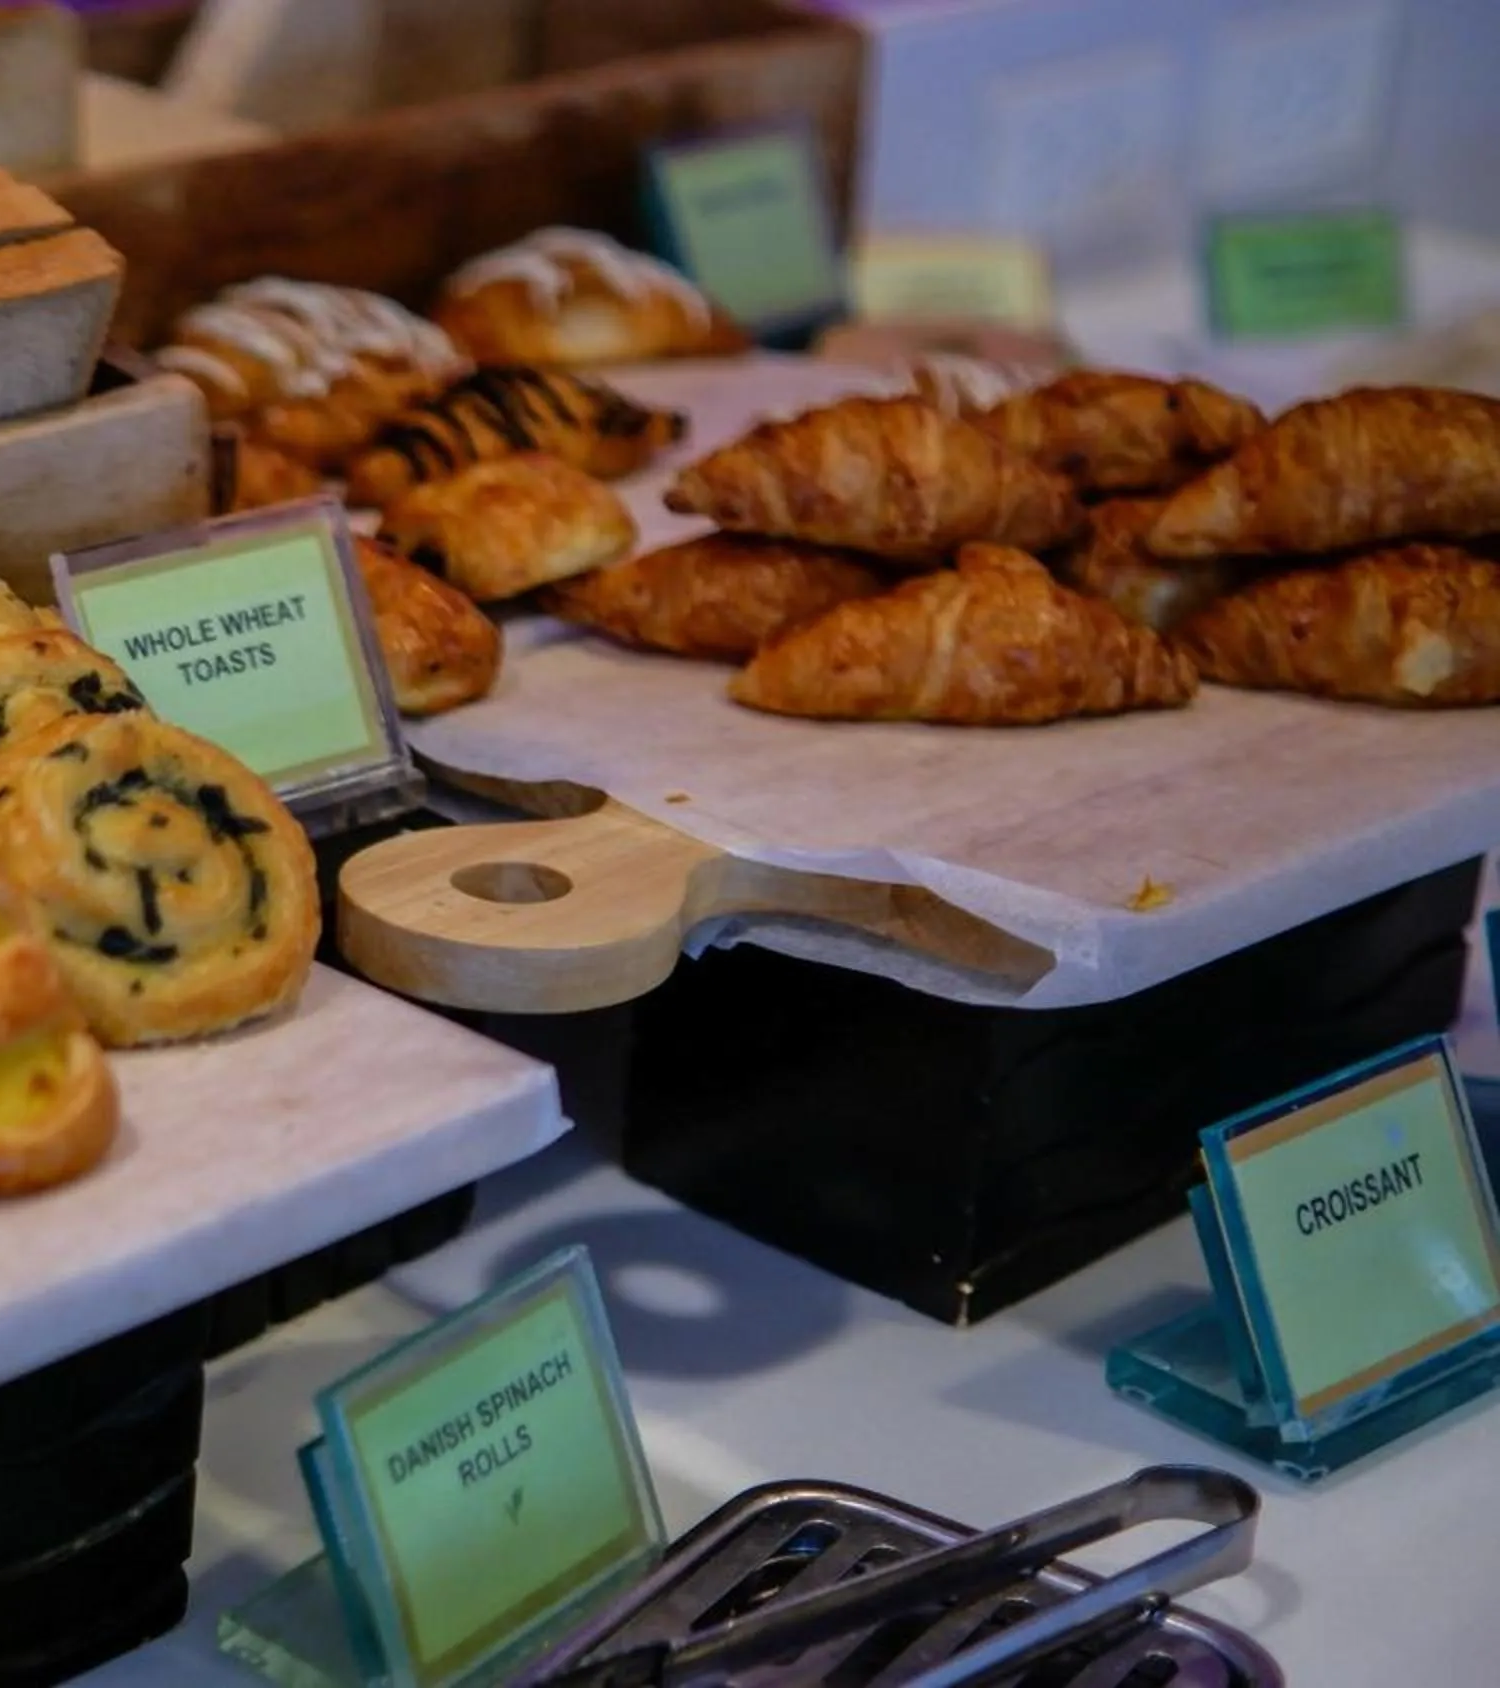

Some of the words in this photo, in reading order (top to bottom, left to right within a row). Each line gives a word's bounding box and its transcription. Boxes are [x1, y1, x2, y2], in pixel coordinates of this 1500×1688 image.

[124, 619, 217, 660] WHOLE
[219, 596, 306, 638] WHEAT
[178, 643, 276, 685] TOASTS
[1296, 1153, 1424, 1236] CROISSANT
[387, 1412, 475, 1484] DANISH
[477, 1350, 572, 1428] SPINACH
[457, 1425, 533, 1487] ROLLS
